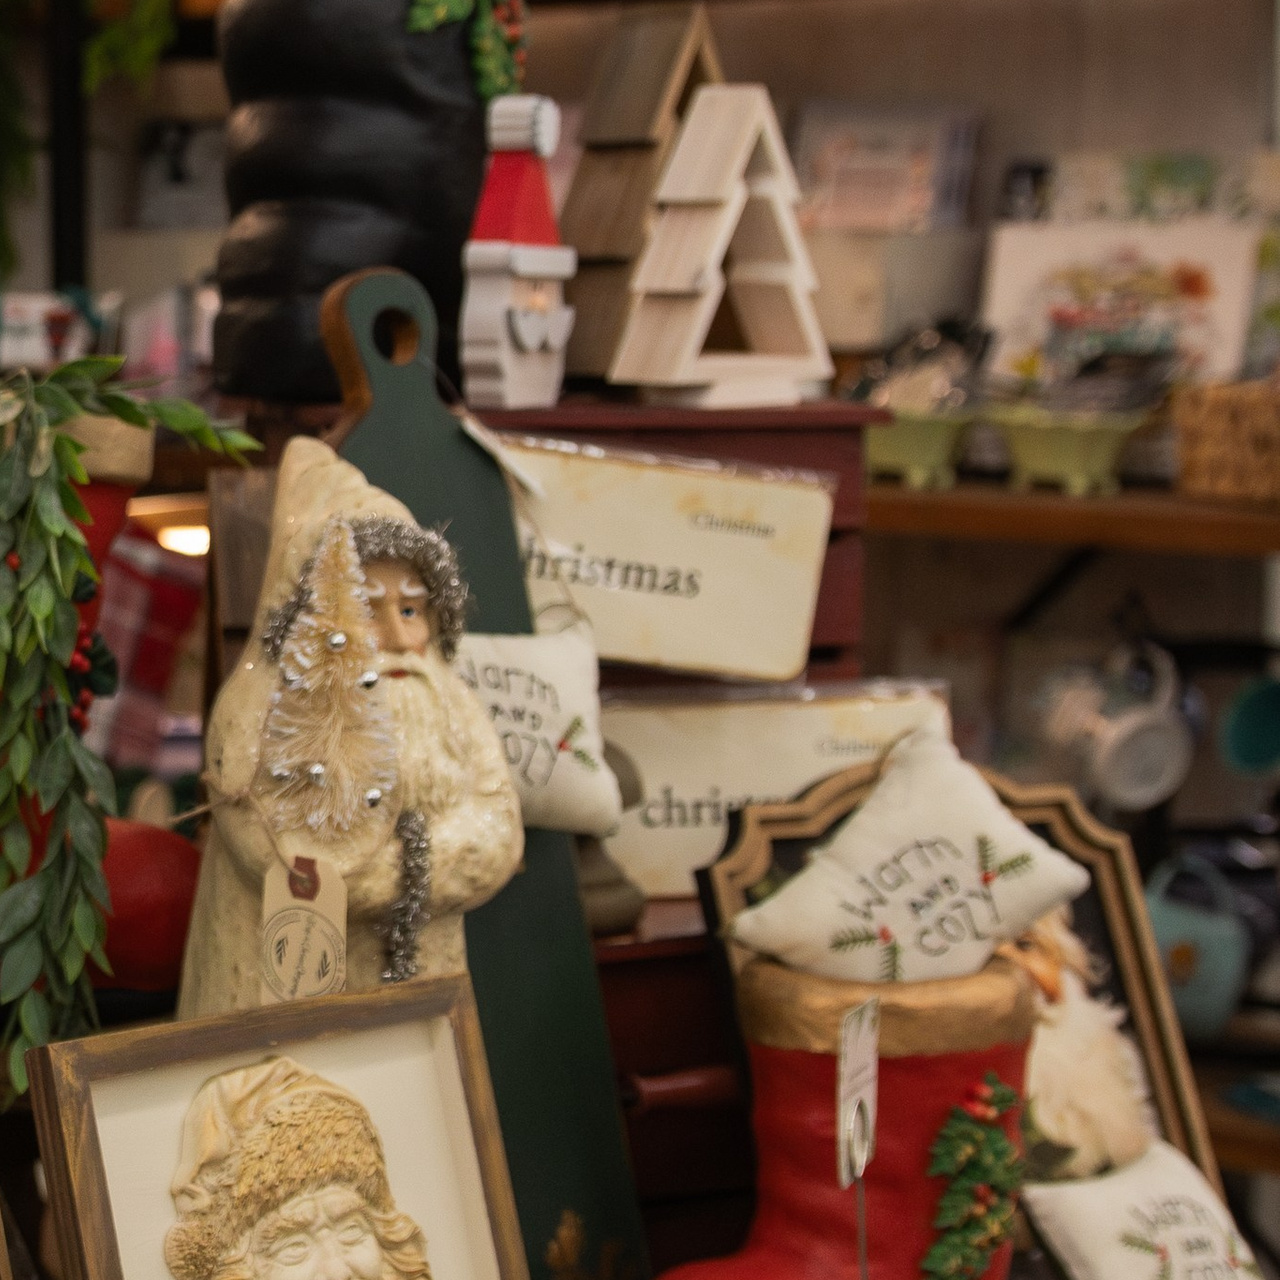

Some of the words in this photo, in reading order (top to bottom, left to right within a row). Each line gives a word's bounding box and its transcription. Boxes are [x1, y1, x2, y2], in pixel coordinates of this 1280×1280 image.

[523, 535, 700, 599] hristmas
[502, 731, 559, 787] OZY
[839, 835, 964, 921] Warm
